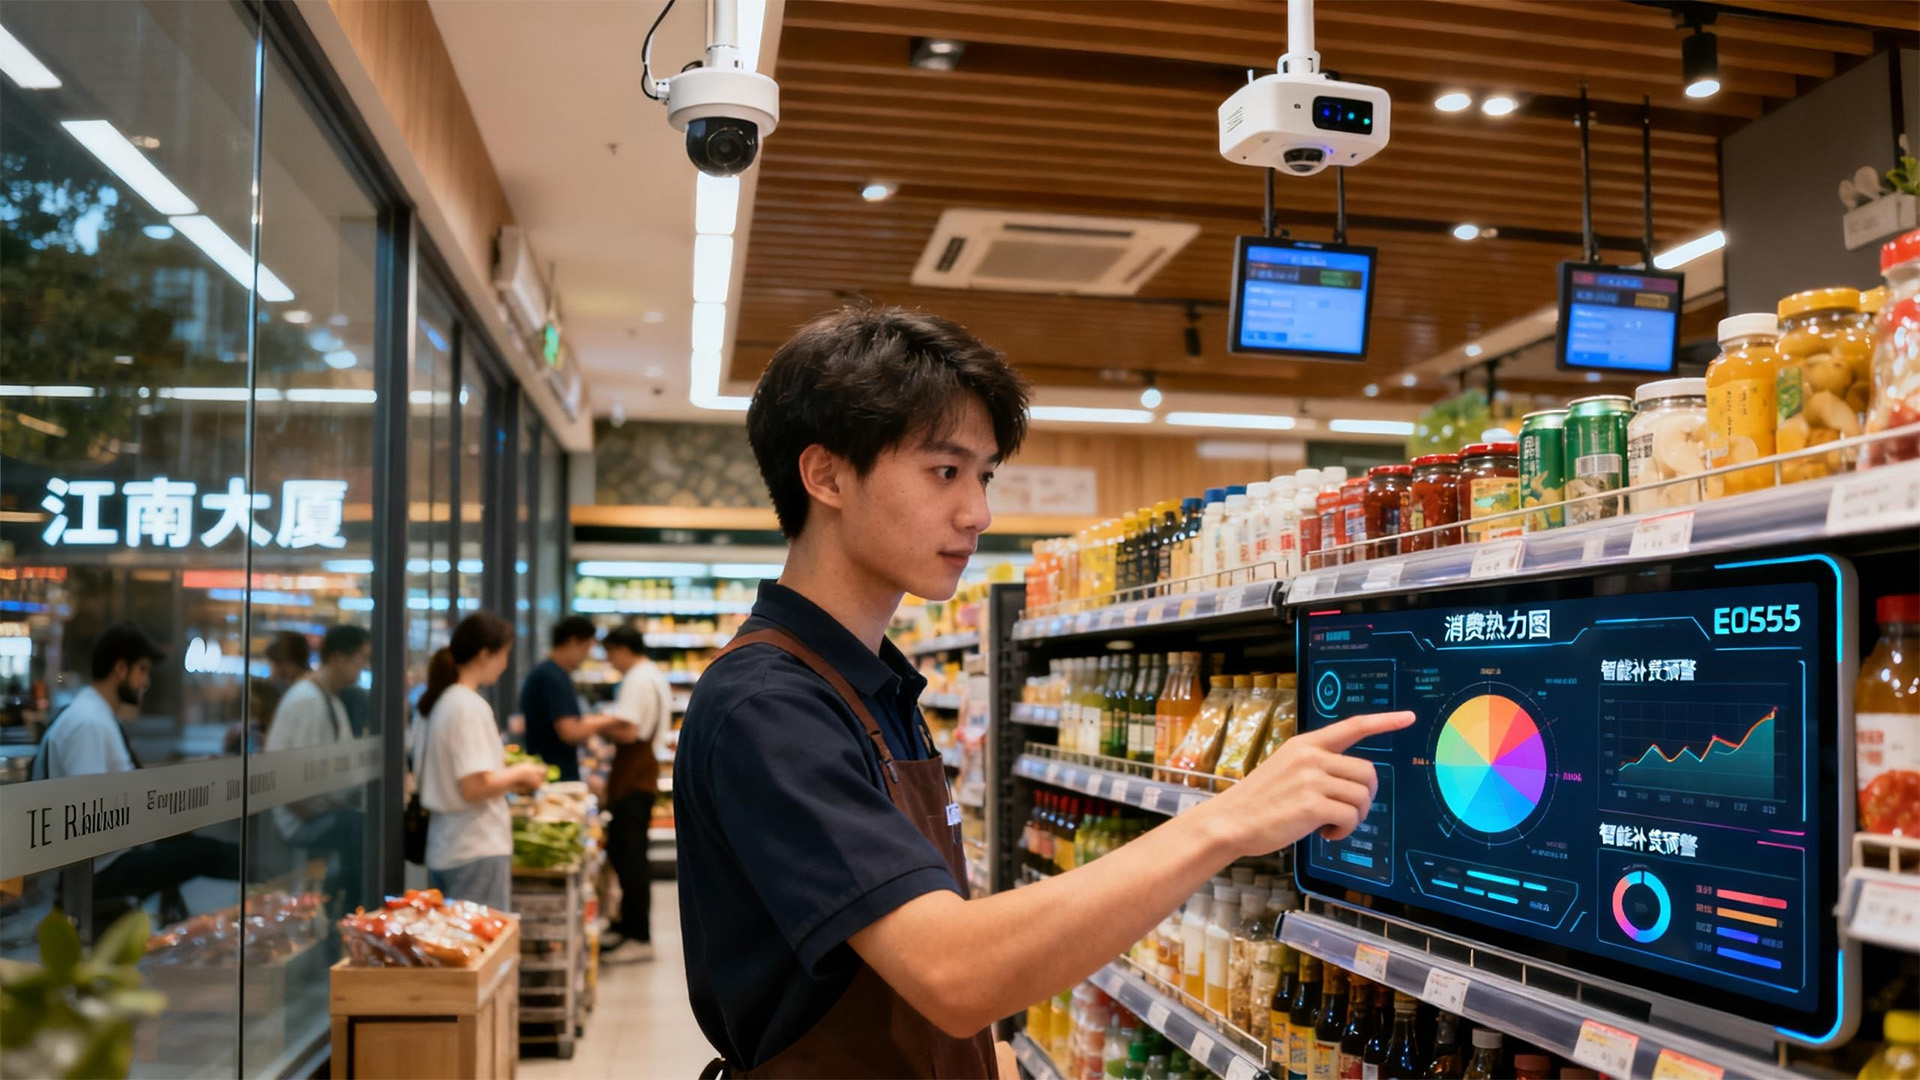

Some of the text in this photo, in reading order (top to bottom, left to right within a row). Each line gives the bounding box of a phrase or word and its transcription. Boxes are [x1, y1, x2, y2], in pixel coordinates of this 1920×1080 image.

[41, 476, 348, 549] 江南大厦
[1444, 609, 1551, 643] 消费热力图
